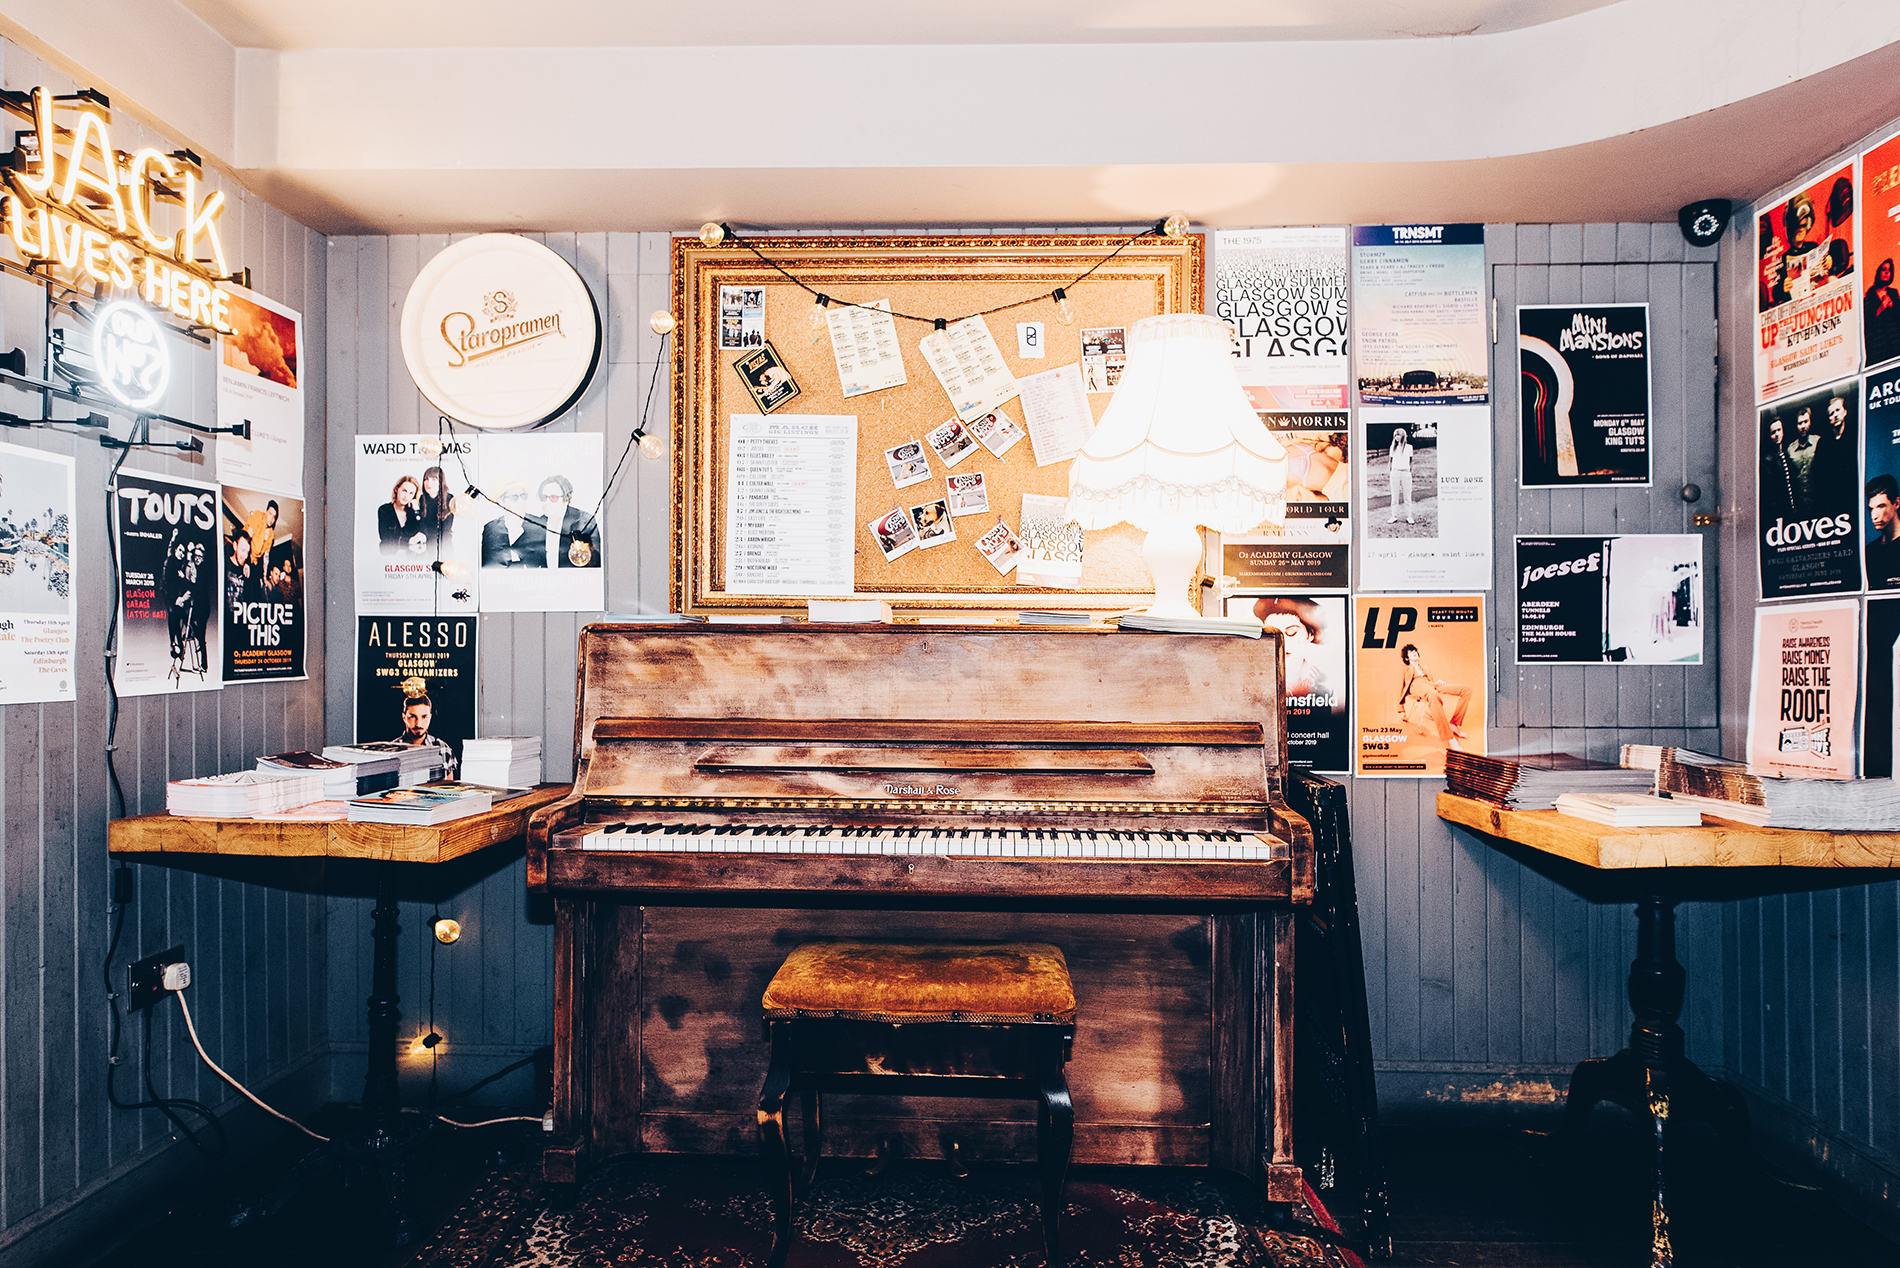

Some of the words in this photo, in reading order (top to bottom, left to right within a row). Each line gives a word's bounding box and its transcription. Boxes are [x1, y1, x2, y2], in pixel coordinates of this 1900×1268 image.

[20, 86, 229, 280] JACK
[1392, 226, 1444, 240] TRNSMT
[12, 195, 135, 289] LIVES
[1243, 236, 1262, 245] 1975
[1216, 278, 1286, 291] GLASGOW
[1216, 286, 1305, 303] GLASGOW
[1216, 301, 1329, 318] GLASGOW
[1760, 323, 1778, 350] UP
[1791, 290, 1853, 333] JUNCTION
[440, 311, 567, 367] Staropramen
[1292, 415, 1347, 428] MORRIS
[1593, 419, 1620, 428] MONDAY
[1630, 418, 1646, 427] MAY
[1608, 427, 1646, 437] GLASGOW
[1605, 436, 1623, 446] KING
[363, 442, 406, 455] WARD
[1440, 476, 1460, 484] LUCY
[118, 487, 215, 530] TOUTS
[1286, 506, 1313, 514] ORLD
[1765, 513, 1853, 547] doves
[1250, 551, 1290, 559] ACADEMY
[1291, 551, 1333, 559] GLASGOW
[385, 564, 424, 572] GLASGOW
[1520, 552, 1601, 590] joesef
[232, 601, 293, 625] PICTURE
[368, 621, 468, 648] ALESSO
[1361, 607, 1418, 649] LP
[248, 624, 281, 647] THIS
[1782, 638, 1798, 649] RAISE
[1799, 636, 1831, 648] AWARENESS
[1782, 650, 1803, 665] RAISE
[1805, 648, 1831, 665] MONEY
[397, 659, 437, 668] GLASGOW
[376, 668, 400, 677] SWG3
[402, 668, 459, 677] GALVANIZERS
[1782, 667, 1810, 687] RAISE
[1811, 666, 1831, 687] THE
[1781, 688, 1831, 724] ROOF!
[1362, 735, 1408, 743] GLASGOW
[1362, 743, 1390, 751] SWG3
[936, 784, 960, 796] Rose
